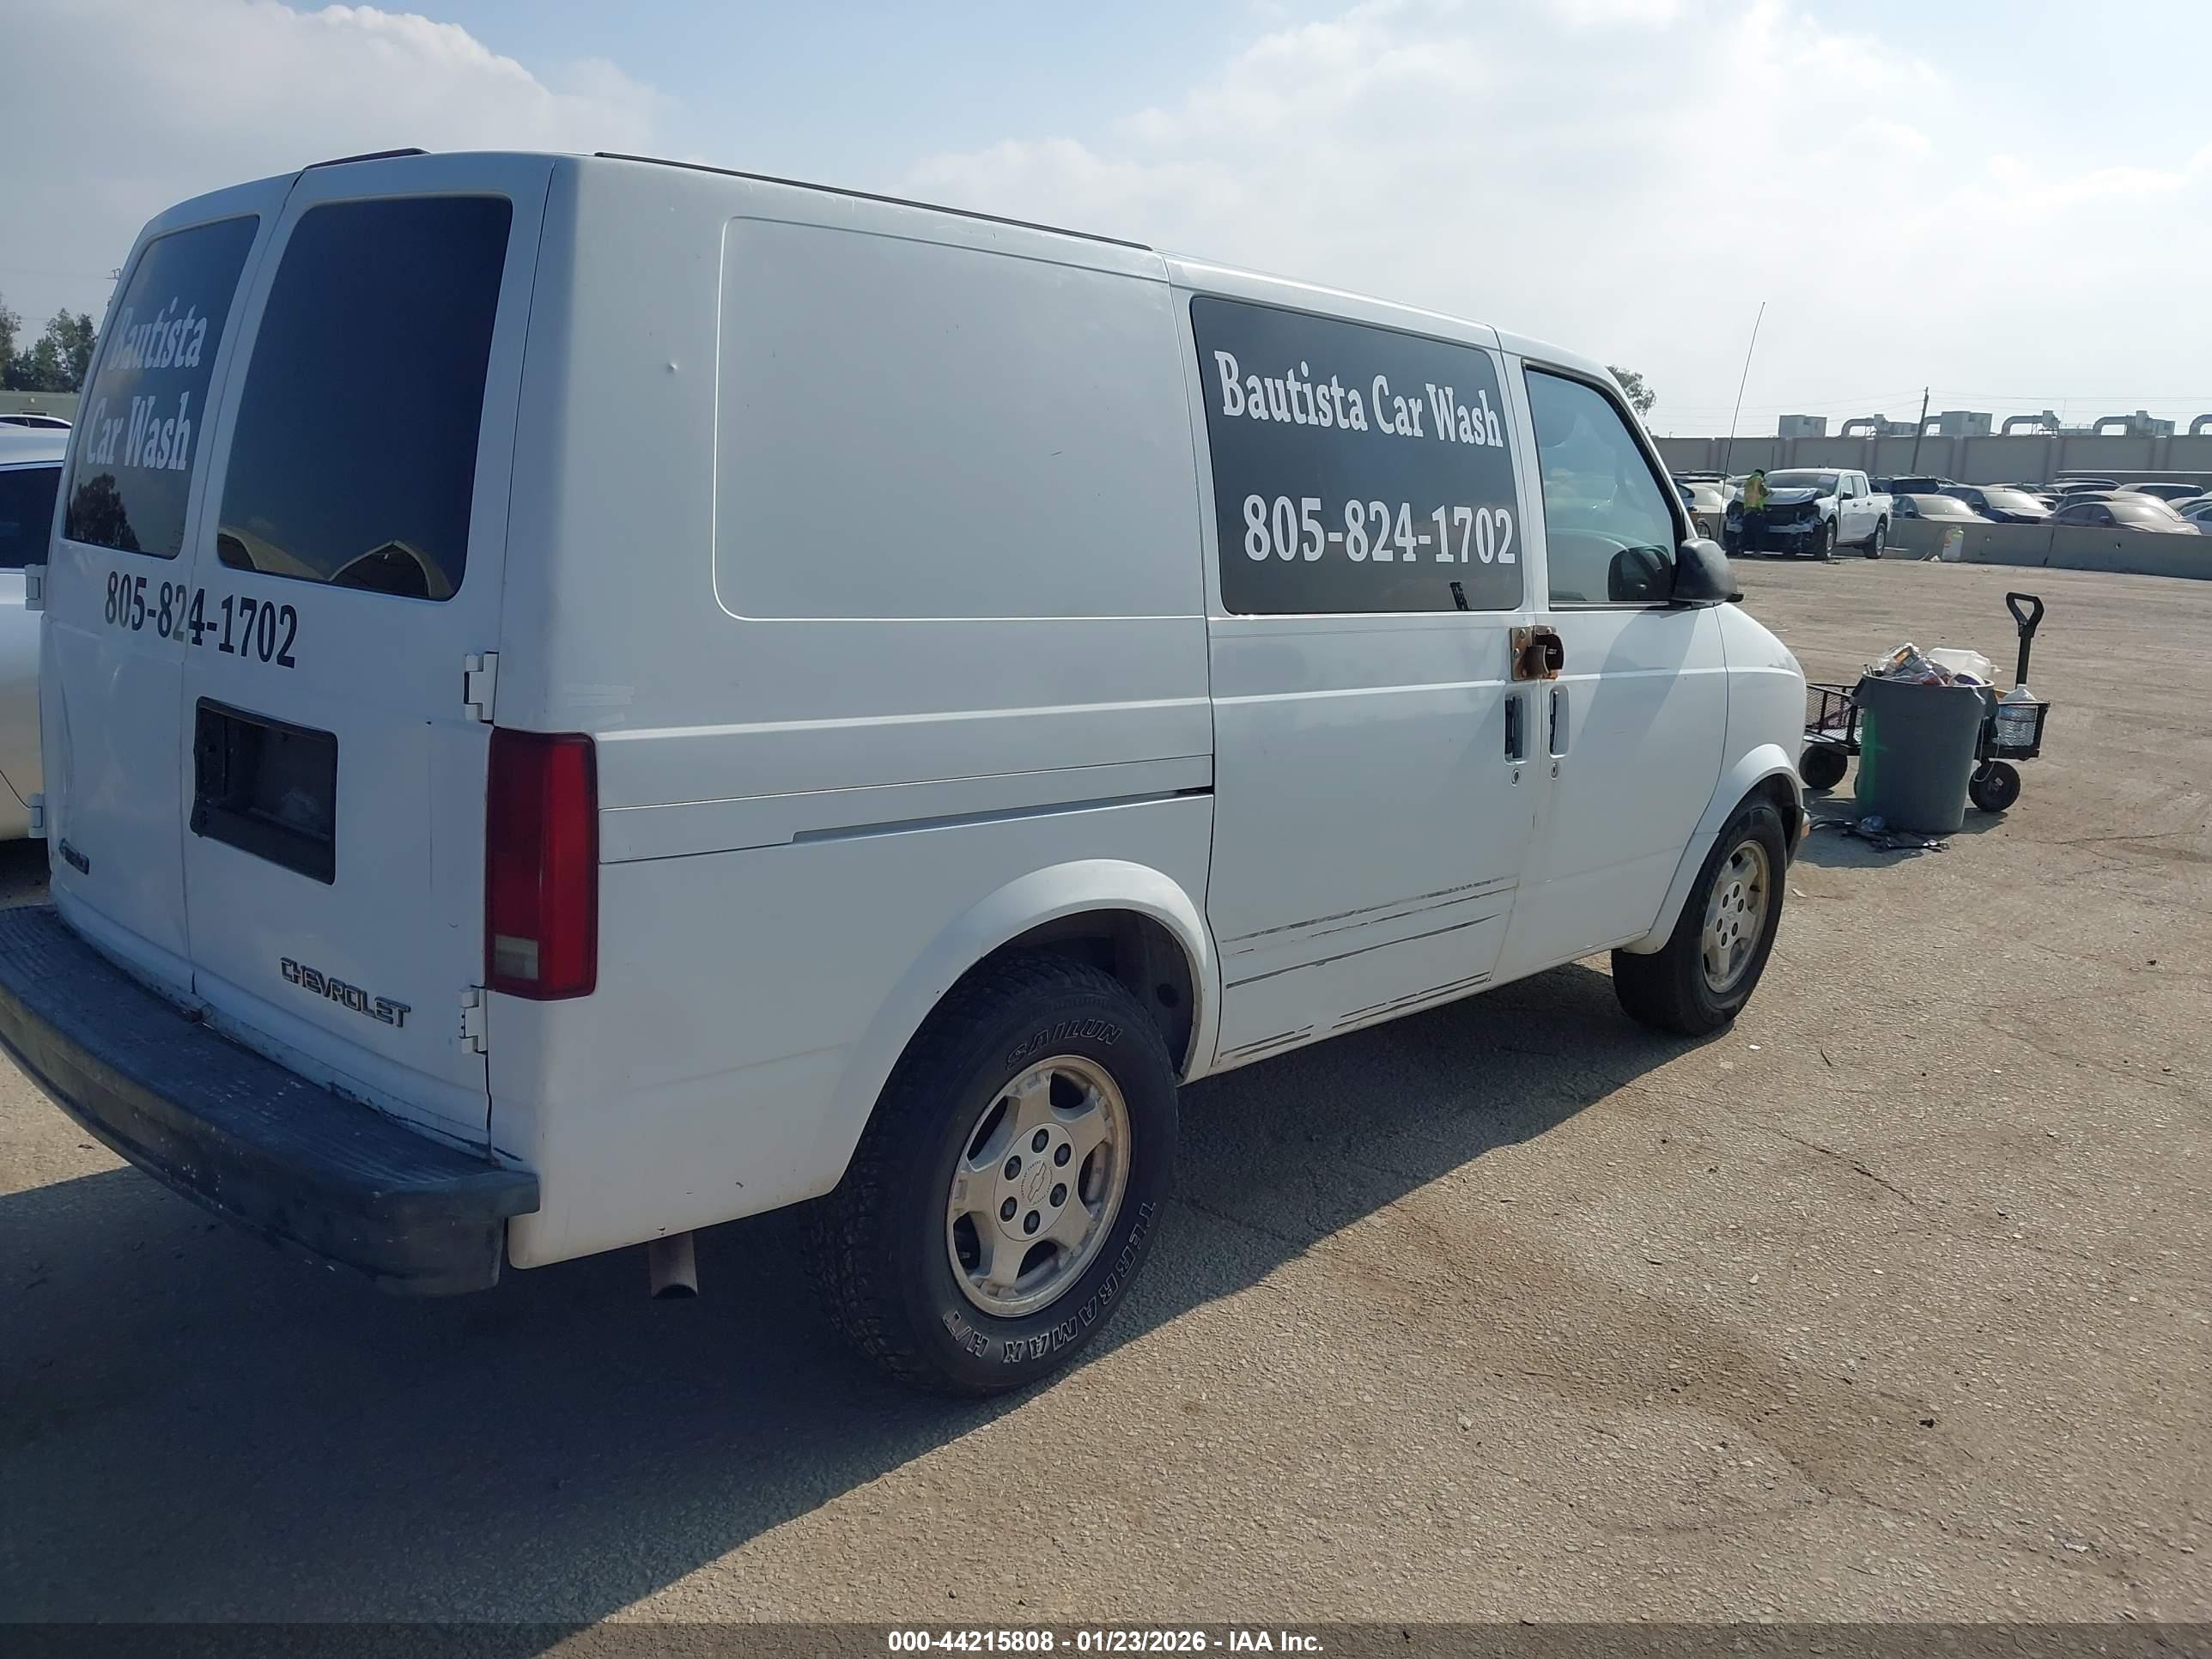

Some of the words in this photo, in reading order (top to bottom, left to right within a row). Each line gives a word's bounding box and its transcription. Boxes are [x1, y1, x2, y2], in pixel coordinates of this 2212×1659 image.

[108, 296, 207, 370] Bautista
[87, 398, 124, 465] Car
[124, 391, 190, 470] Wash
[1213, 349, 1368, 432] Bautista
[1372, 374, 1425, 437] Car
[1425, 383, 1504, 447] Wash
[1243, 495, 1516, 564] 805-824-1702
[104, 570, 298, 668] 805-824-1702
[280, 957, 411, 1028] CHEVROLET
[1006, 1018, 1123, 1071] SAILUN
[1003, 1202, 1156, 1364] TERRAMAX
[942, 1310, 990, 1358] H/T
